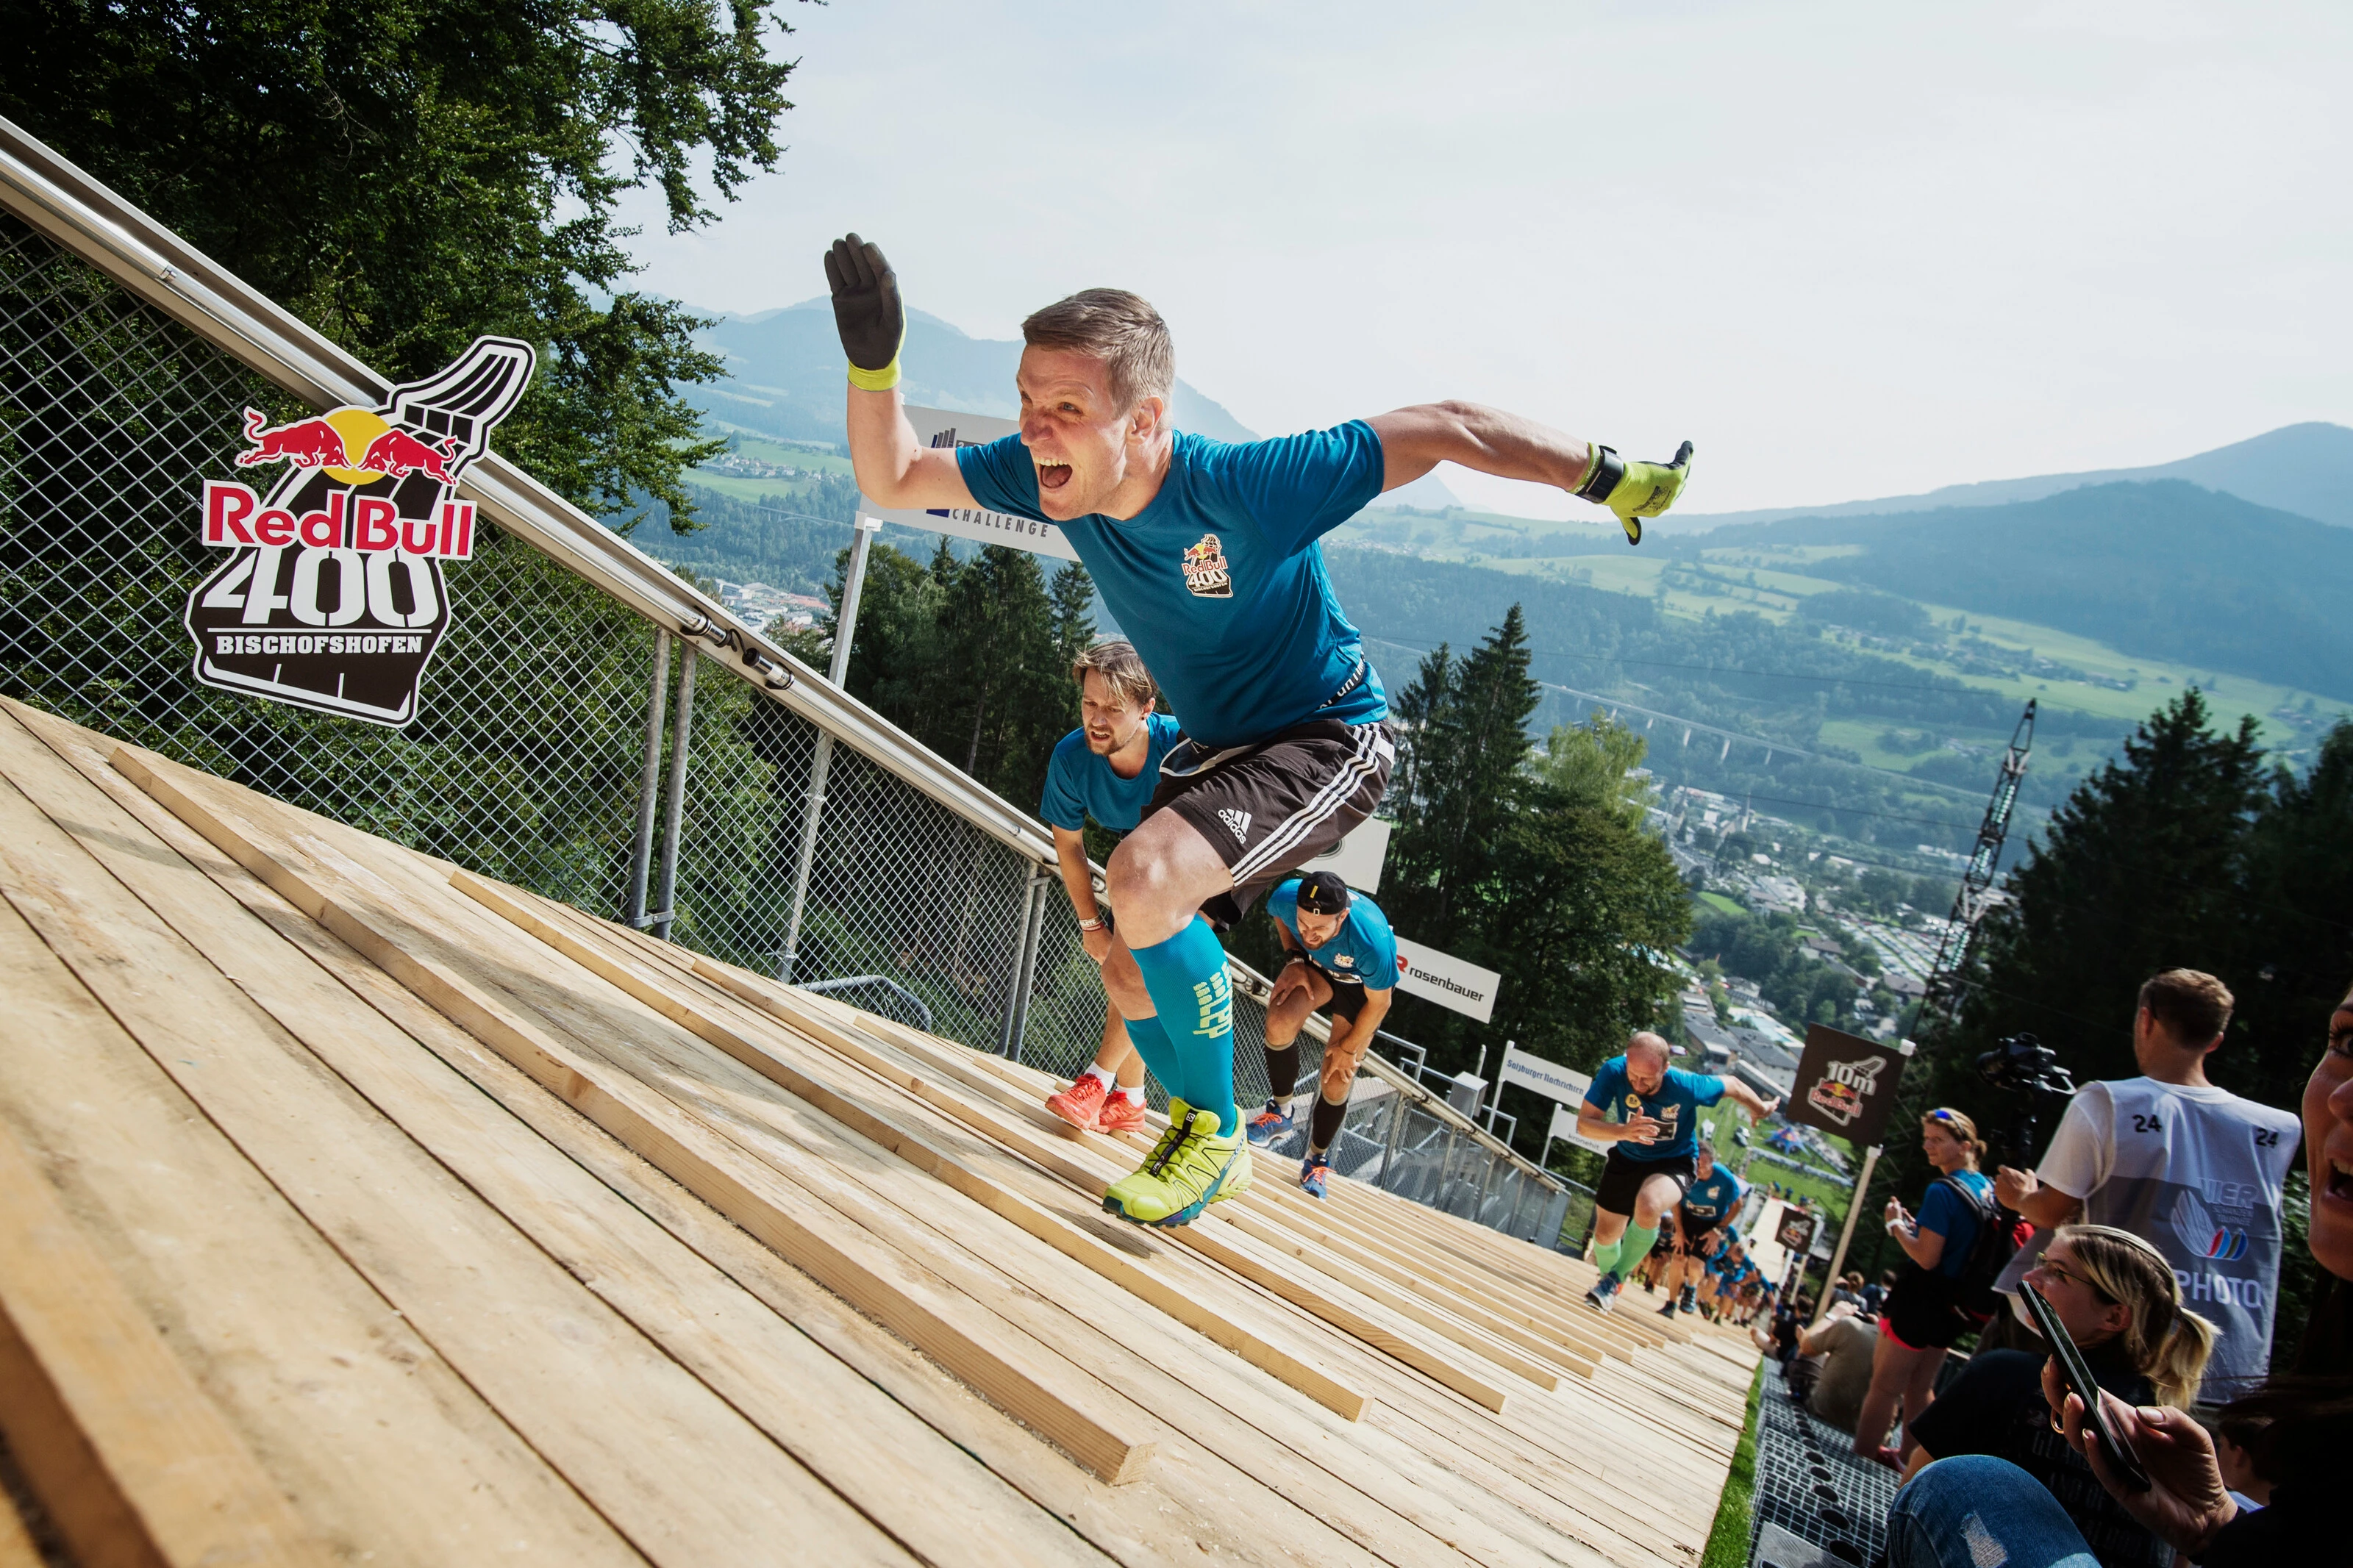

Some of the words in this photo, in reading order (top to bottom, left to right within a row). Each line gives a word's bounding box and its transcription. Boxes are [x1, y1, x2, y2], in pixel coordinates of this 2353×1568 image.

[209, 486, 344, 548] Red
[356, 498, 472, 556] Bull
[952, 509, 1049, 537] CHALLENGE
[1182, 561, 1205, 575] Red
[1205, 557, 1227, 571] Bull
[1188, 569, 1228, 587] 400
[201, 547, 440, 628] 400
[216, 635, 423, 654] BISCHOFSHOFEN
[1218, 809, 1246, 845] adidas
[1410, 967, 1485, 1002] rosenbauer
[1507, 1059, 1543, 1079] Salzburger
[1544, 1073, 1585, 1096] Nachrichten
[1828, 1062, 1874, 1093] 10m
[1810, 1089, 1835, 1106] Red
[1835, 1096, 1860, 1115] Bull
[2132, 1114, 2163, 1133] 24
[2254, 1128, 2279, 1148] 24
[2197, 1177, 2259, 1209] VIER
[2173, 1270, 2263, 1308] PHOTO
